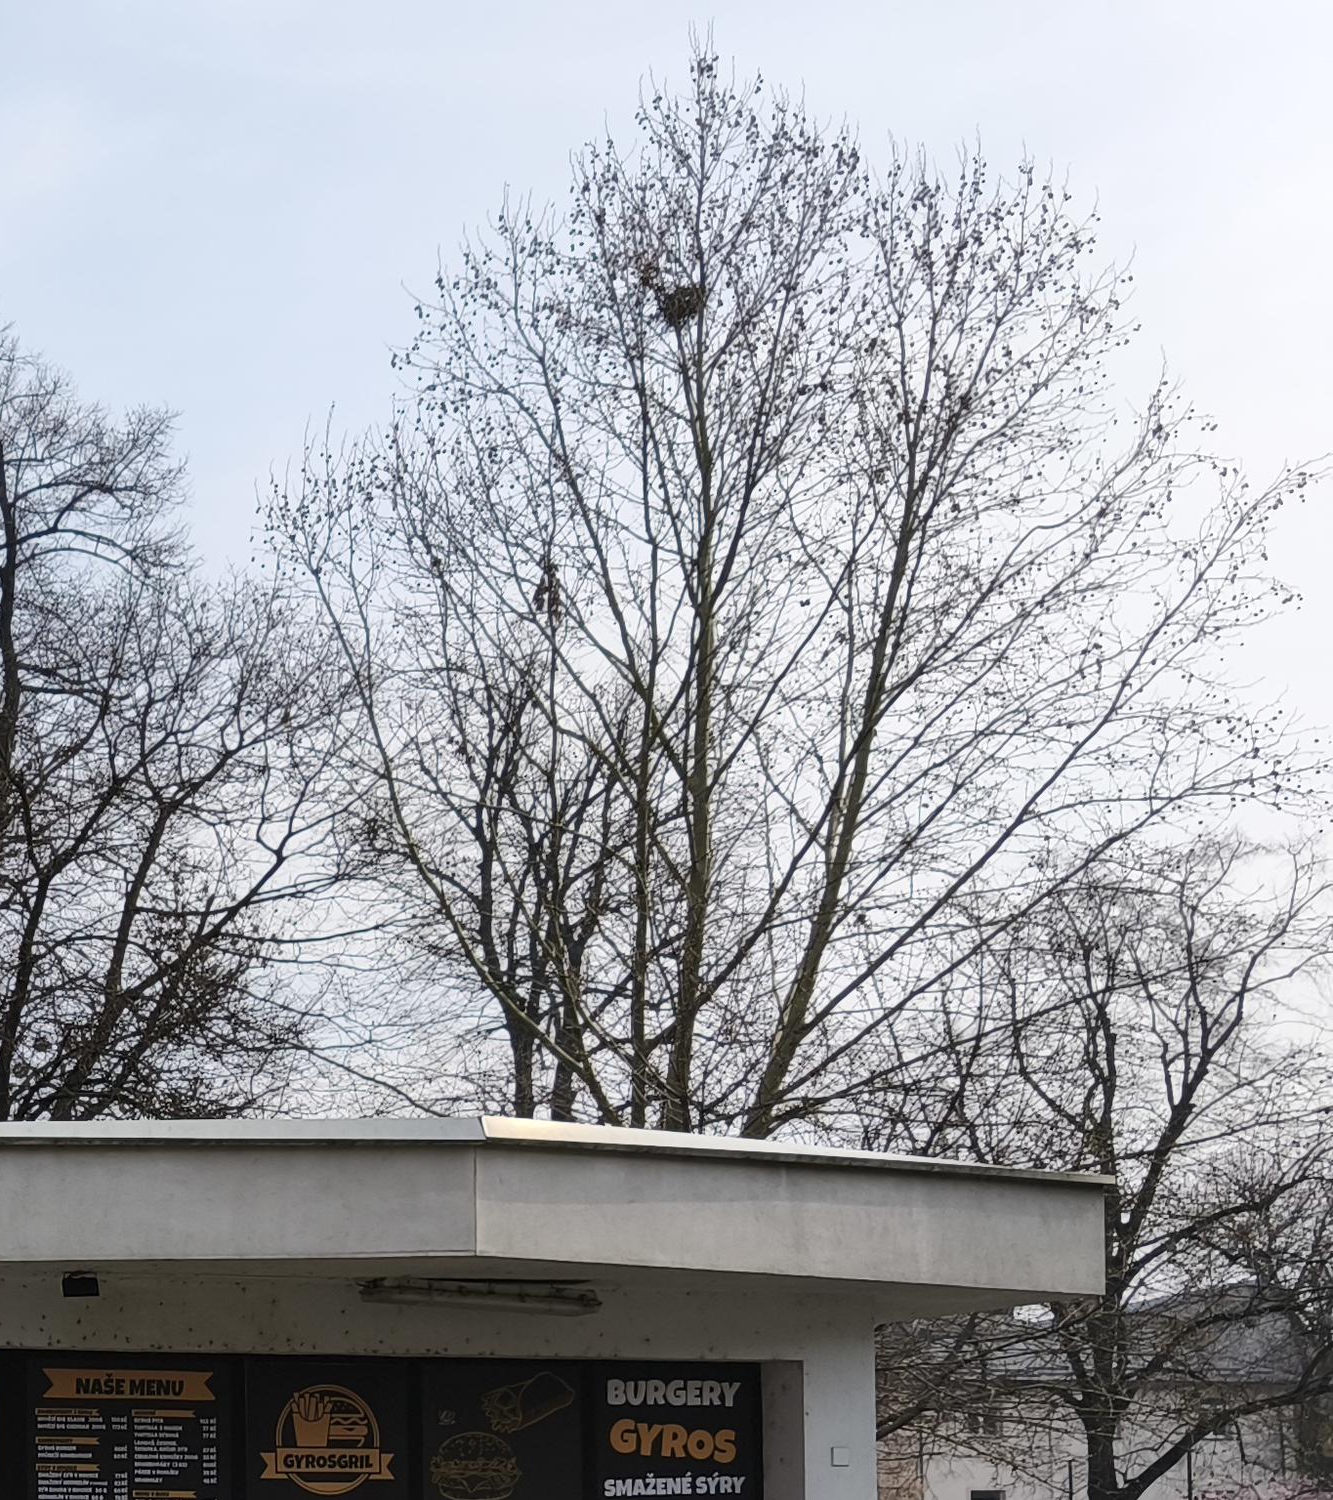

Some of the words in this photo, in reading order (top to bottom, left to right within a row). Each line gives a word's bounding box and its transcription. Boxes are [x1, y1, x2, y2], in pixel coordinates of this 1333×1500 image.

[75, 1373, 125, 1395] NAŠE
[129, 1379, 184, 1397] MENU
[606, 1378, 741, 1407] BURGERY
[609, 1418, 737, 1464] GYROS
[283, 1453, 374, 1470] GYROSGRIL
[603, 1472, 692, 1497] SMAŽENÉ
[695, 1472, 746, 1495] SÝRY
